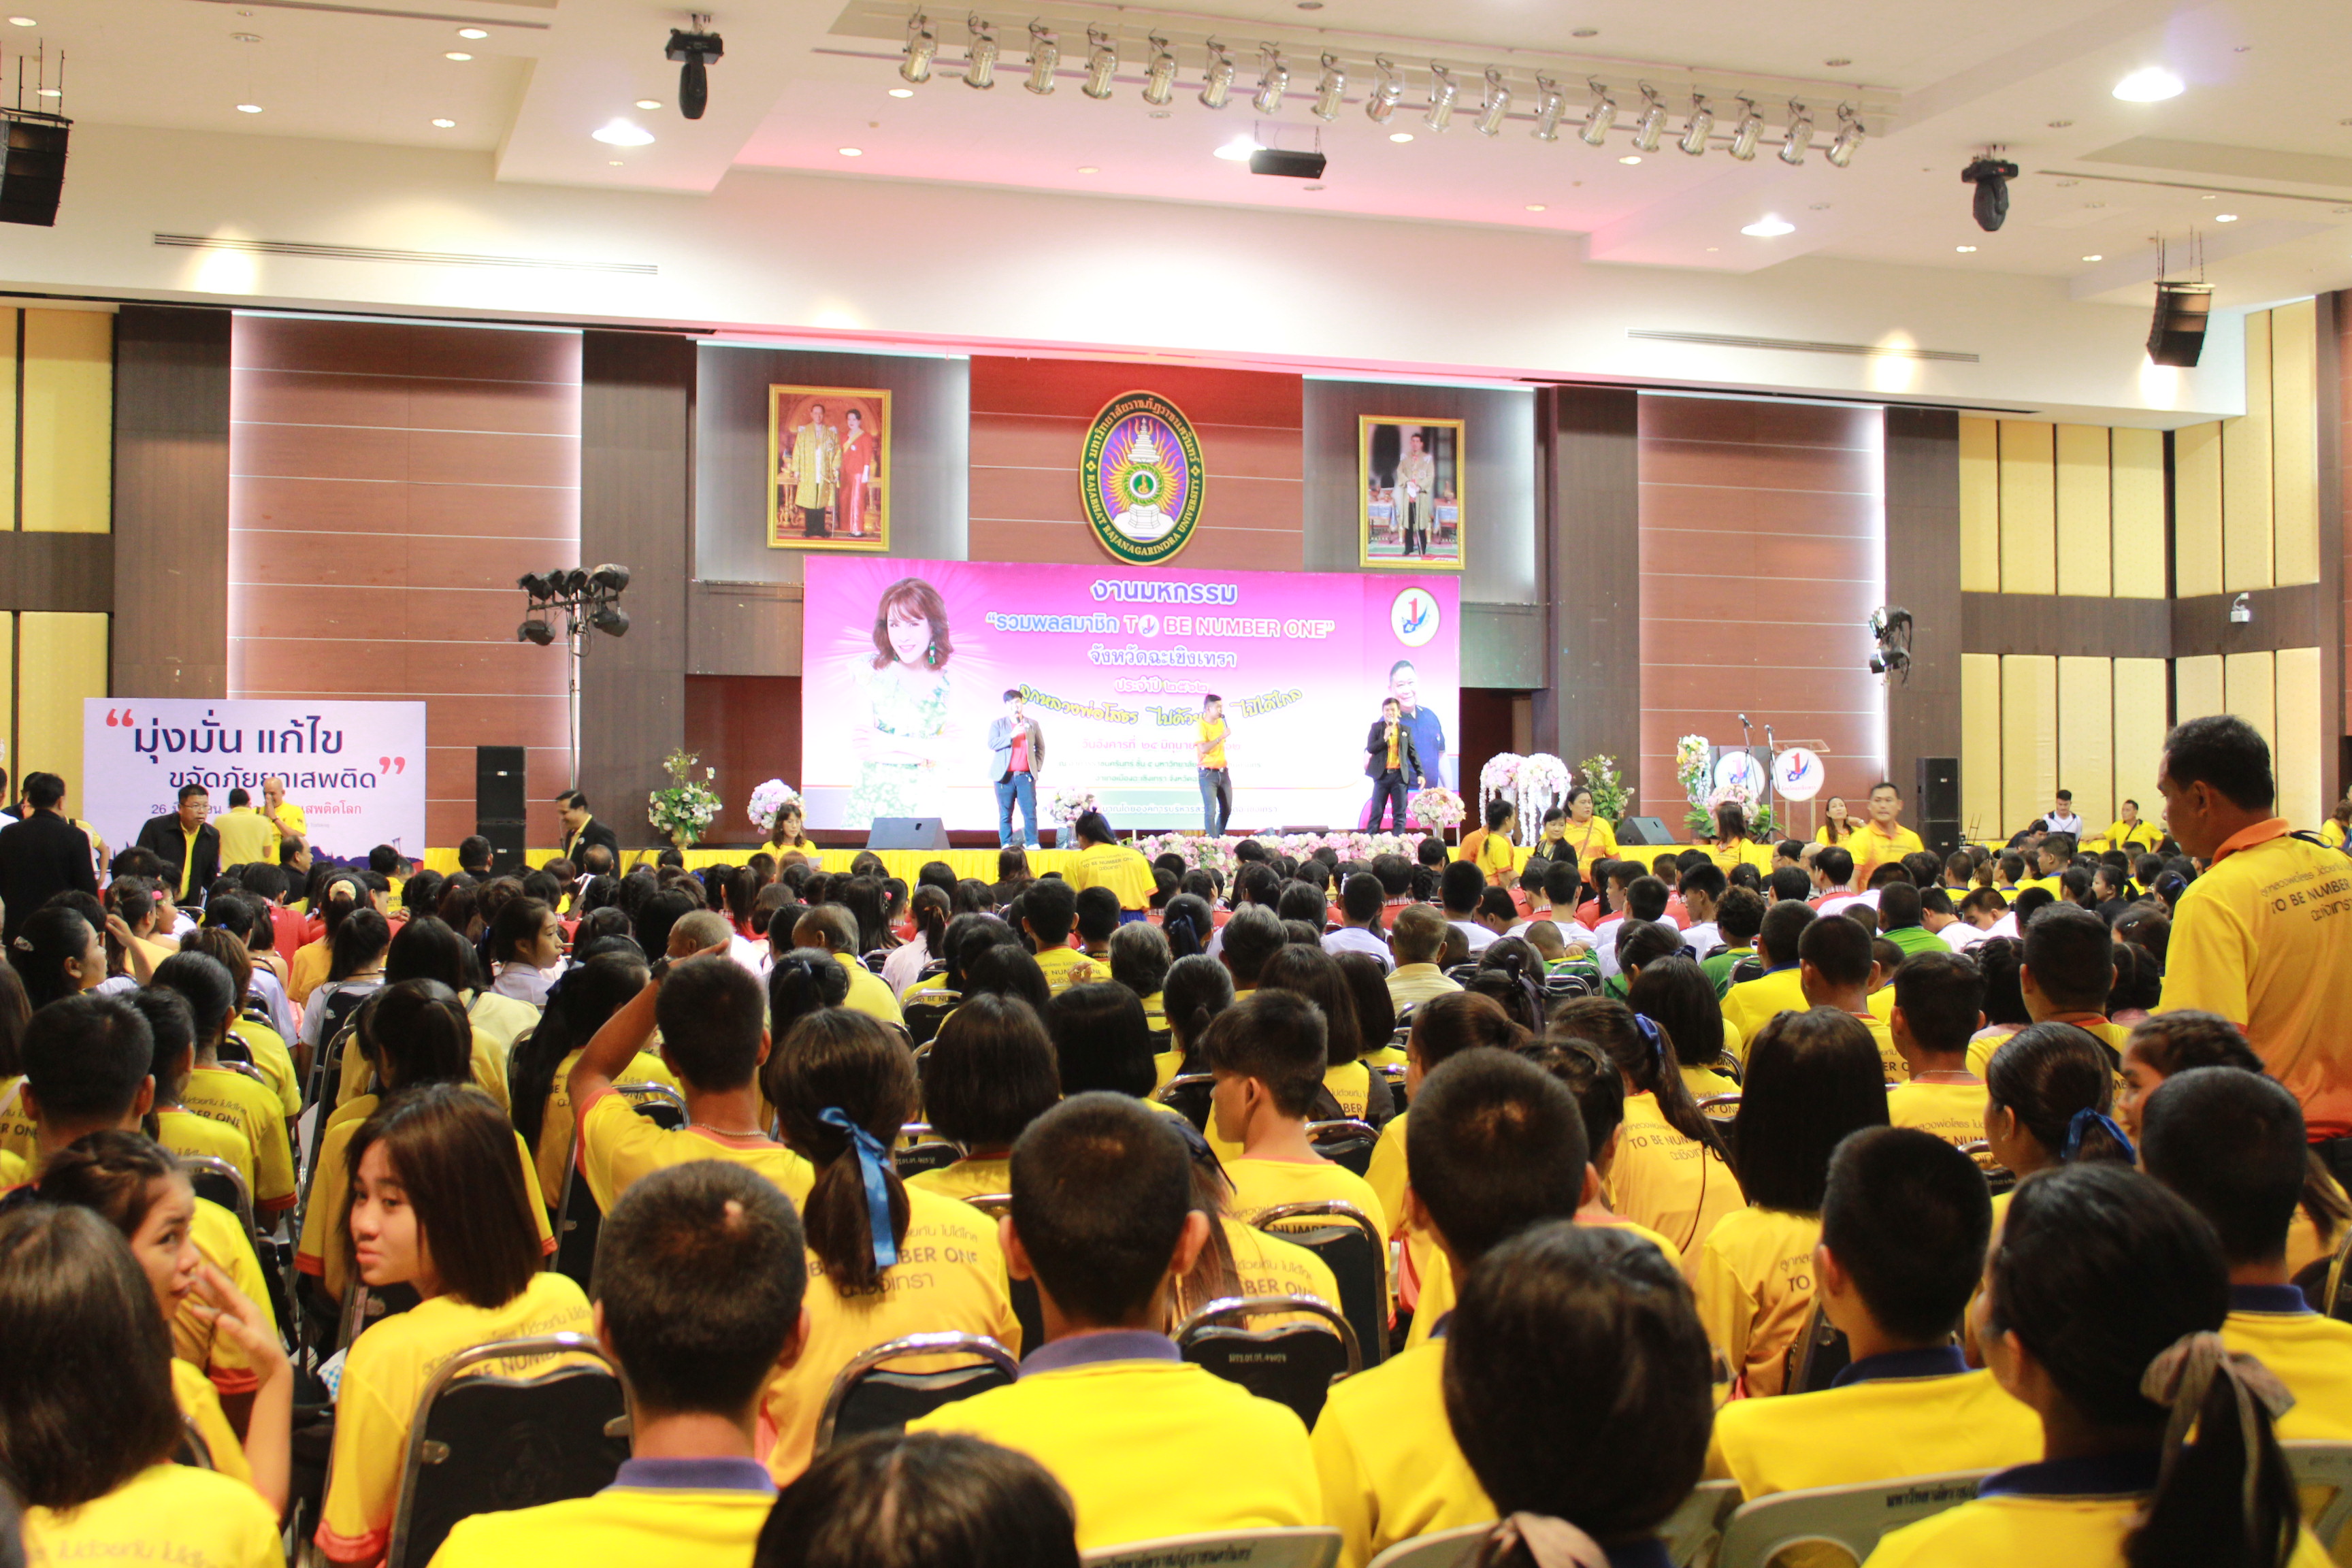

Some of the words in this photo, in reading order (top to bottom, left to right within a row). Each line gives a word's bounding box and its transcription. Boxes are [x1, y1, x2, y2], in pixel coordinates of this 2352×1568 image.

[1087, 474, 1105, 523] RAJABHAT
[1102, 525, 1181, 556] RAJANAGARINDRA
[1178, 478, 1200, 532] UNIVERSITY
[1092, 581, 1237, 604] งานมหกรรม
[1165, 617, 1191, 634] BE
[1196, 617, 1279, 636] NUMBER
[1090, 644, 1237, 667] จังหวัดฉะเชิงเทรา
[1116, 676, 1161, 692] ประจำปี
[258, 715, 342, 753] แก้ไข
[1161, 739, 1196, 753] มิถุนาย
[151, 804, 167, 815] 26
[2289, 892, 2306, 906] BE
[2306, 878, 2350, 900] NUMBER
[1343, 1102, 1363, 1113] BER
[14, 1123, 37, 1139] ON
[1629, 1136, 1648, 1149] TO
[1650, 1134, 1664, 1145] BE
[1664, 1135, 1690, 1146] NUM
[808, 1261, 825, 1277] B
[898, 1247, 937, 1264] BER
[1244, 1278, 1280, 1294] BER
[1787, 1275, 1810, 1293] TO
